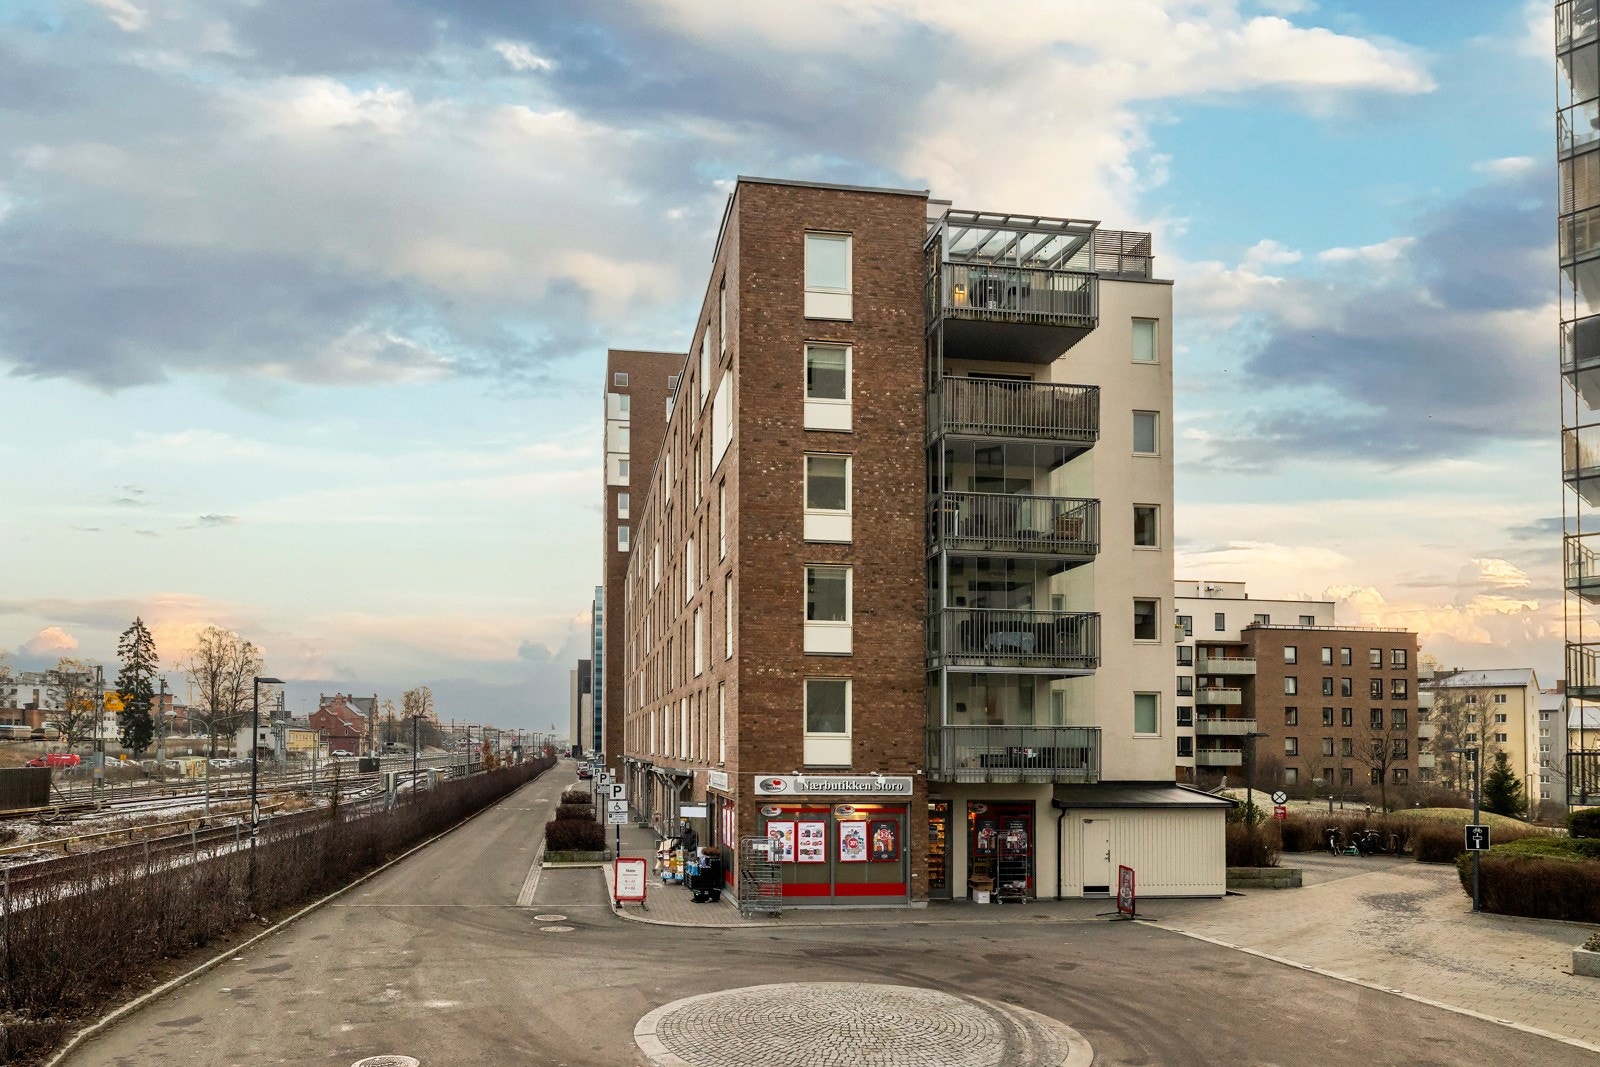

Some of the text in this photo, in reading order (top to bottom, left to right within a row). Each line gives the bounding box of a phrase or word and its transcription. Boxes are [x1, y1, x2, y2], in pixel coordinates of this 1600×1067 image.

[599, 773, 607, 784] P
[802, 780, 904, 791] Nærbutikken Storo
[613, 785, 622, 798] P
